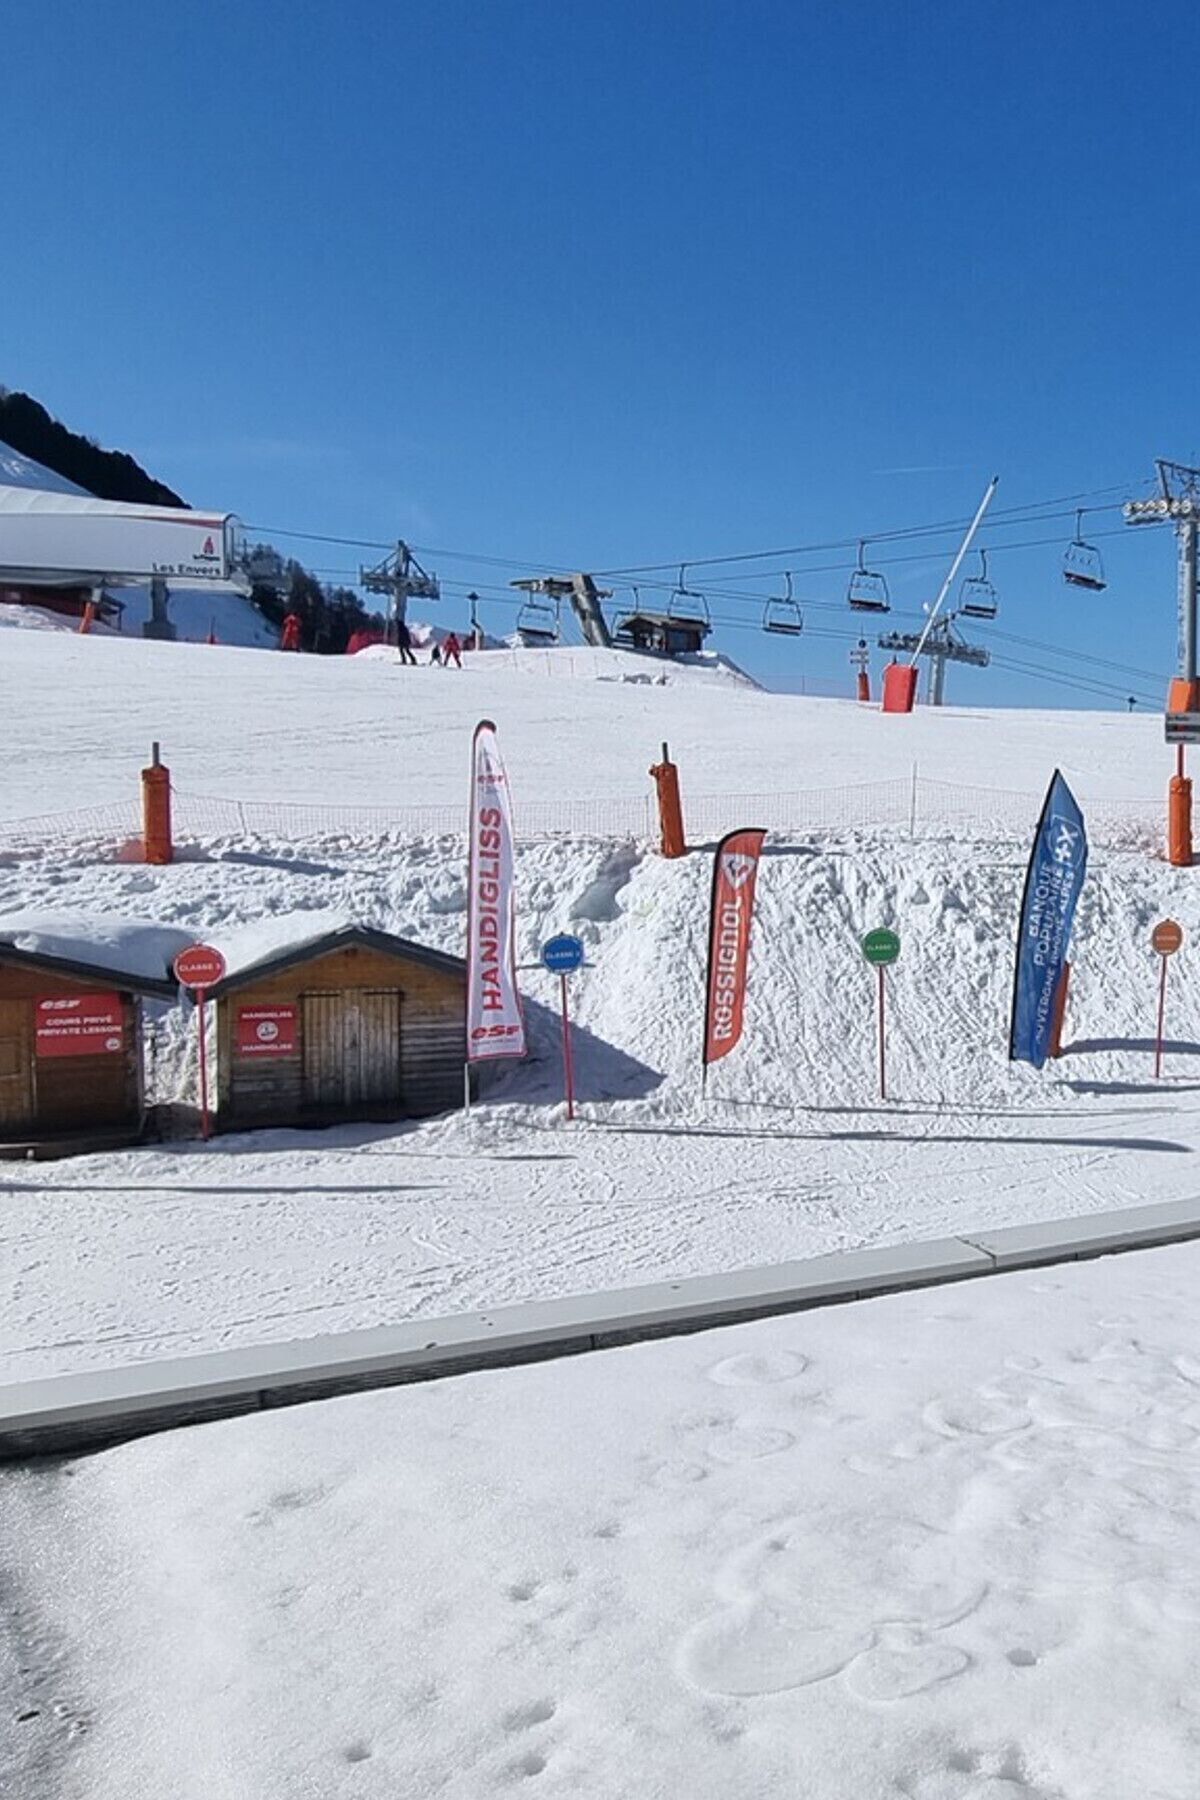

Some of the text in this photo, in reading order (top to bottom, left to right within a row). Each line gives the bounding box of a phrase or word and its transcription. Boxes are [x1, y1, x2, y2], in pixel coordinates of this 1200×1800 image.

[152, 562, 220, 575] Les Envers
[1028, 861, 1051, 938] BANQUE
[479, 807, 503, 1011] HANDIGLISS
[1033, 866, 1063, 967] POPULAIRE
[545, 951, 573, 960] CLASSE
[179, 963, 213, 972] CLASSE
[713, 896, 742, 1041] ROSSIGNOL
[46, 1017, 81, 1026] COURS
[37, 1024, 122, 1036] PRIVATE LESSON
